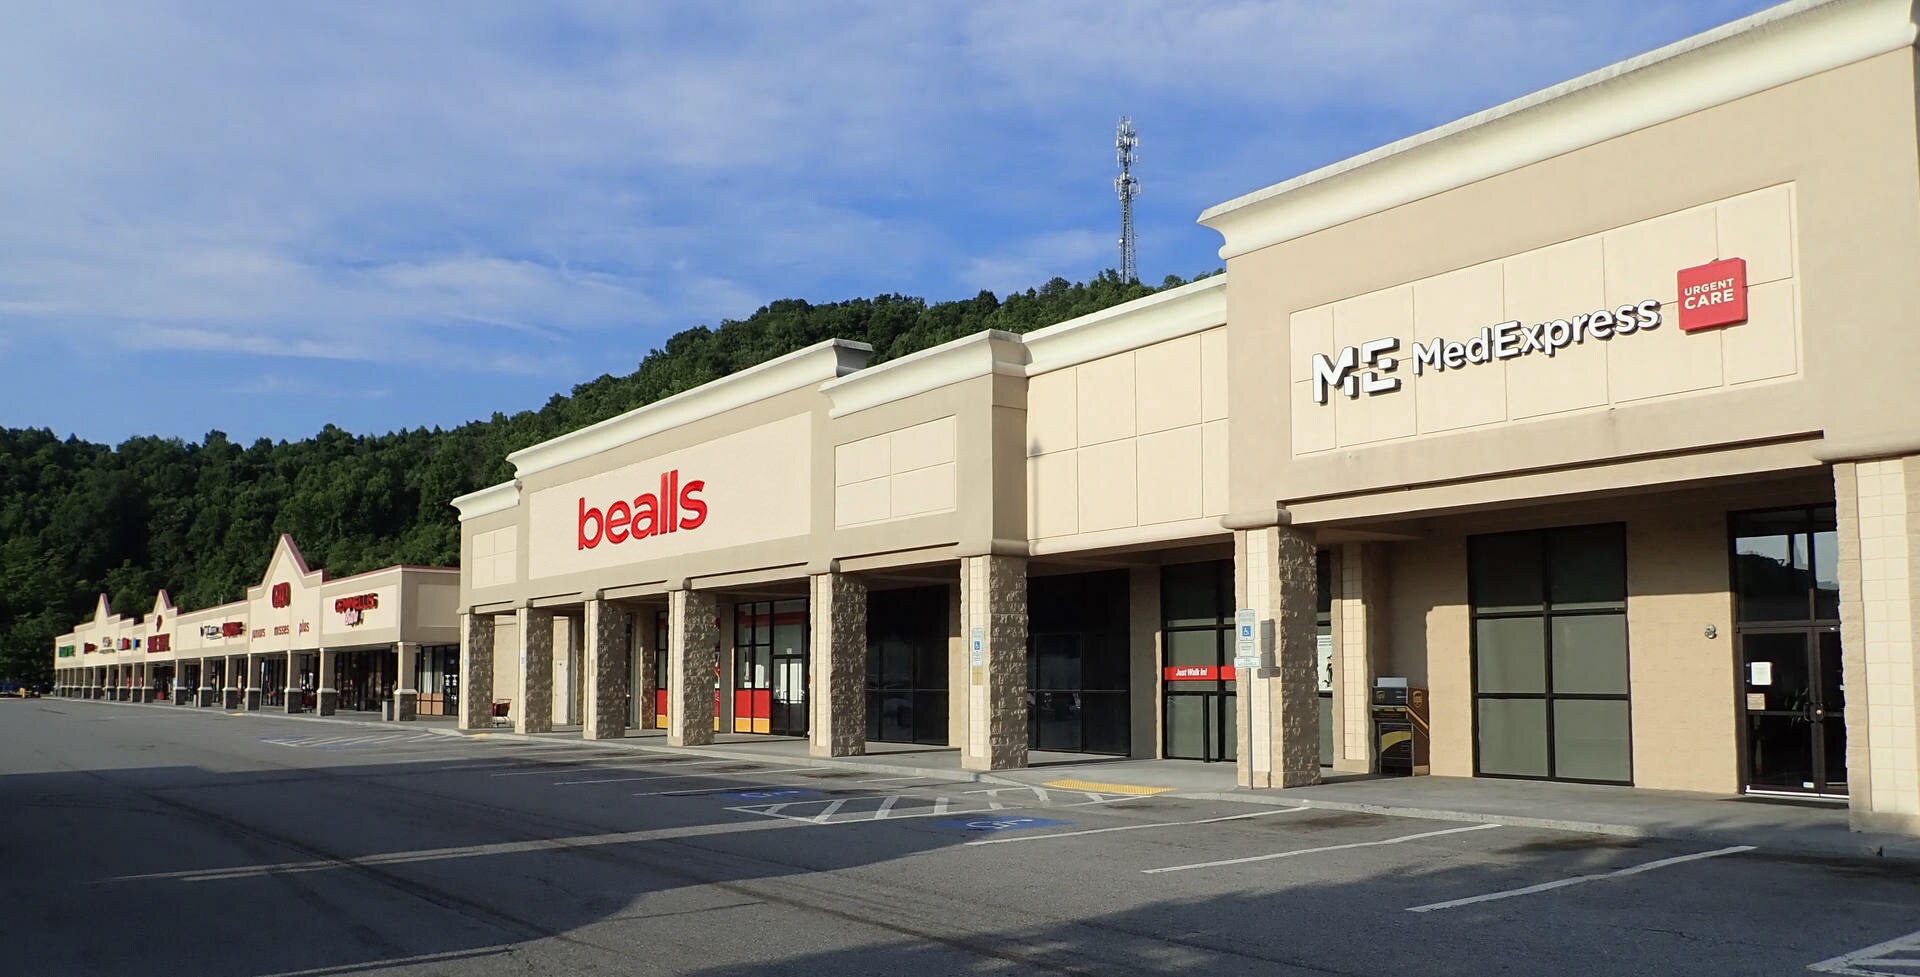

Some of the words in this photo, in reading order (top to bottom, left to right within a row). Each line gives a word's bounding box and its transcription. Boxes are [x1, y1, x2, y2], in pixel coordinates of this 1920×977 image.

[1684, 277, 1735, 298] URGENT
[1684, 290, 1735, 310] CARE
[1412, 300, 1661, 375] MedExpress
[578, 469, 708, 550] bealls
[1176, 668, 1187, 676] Just
